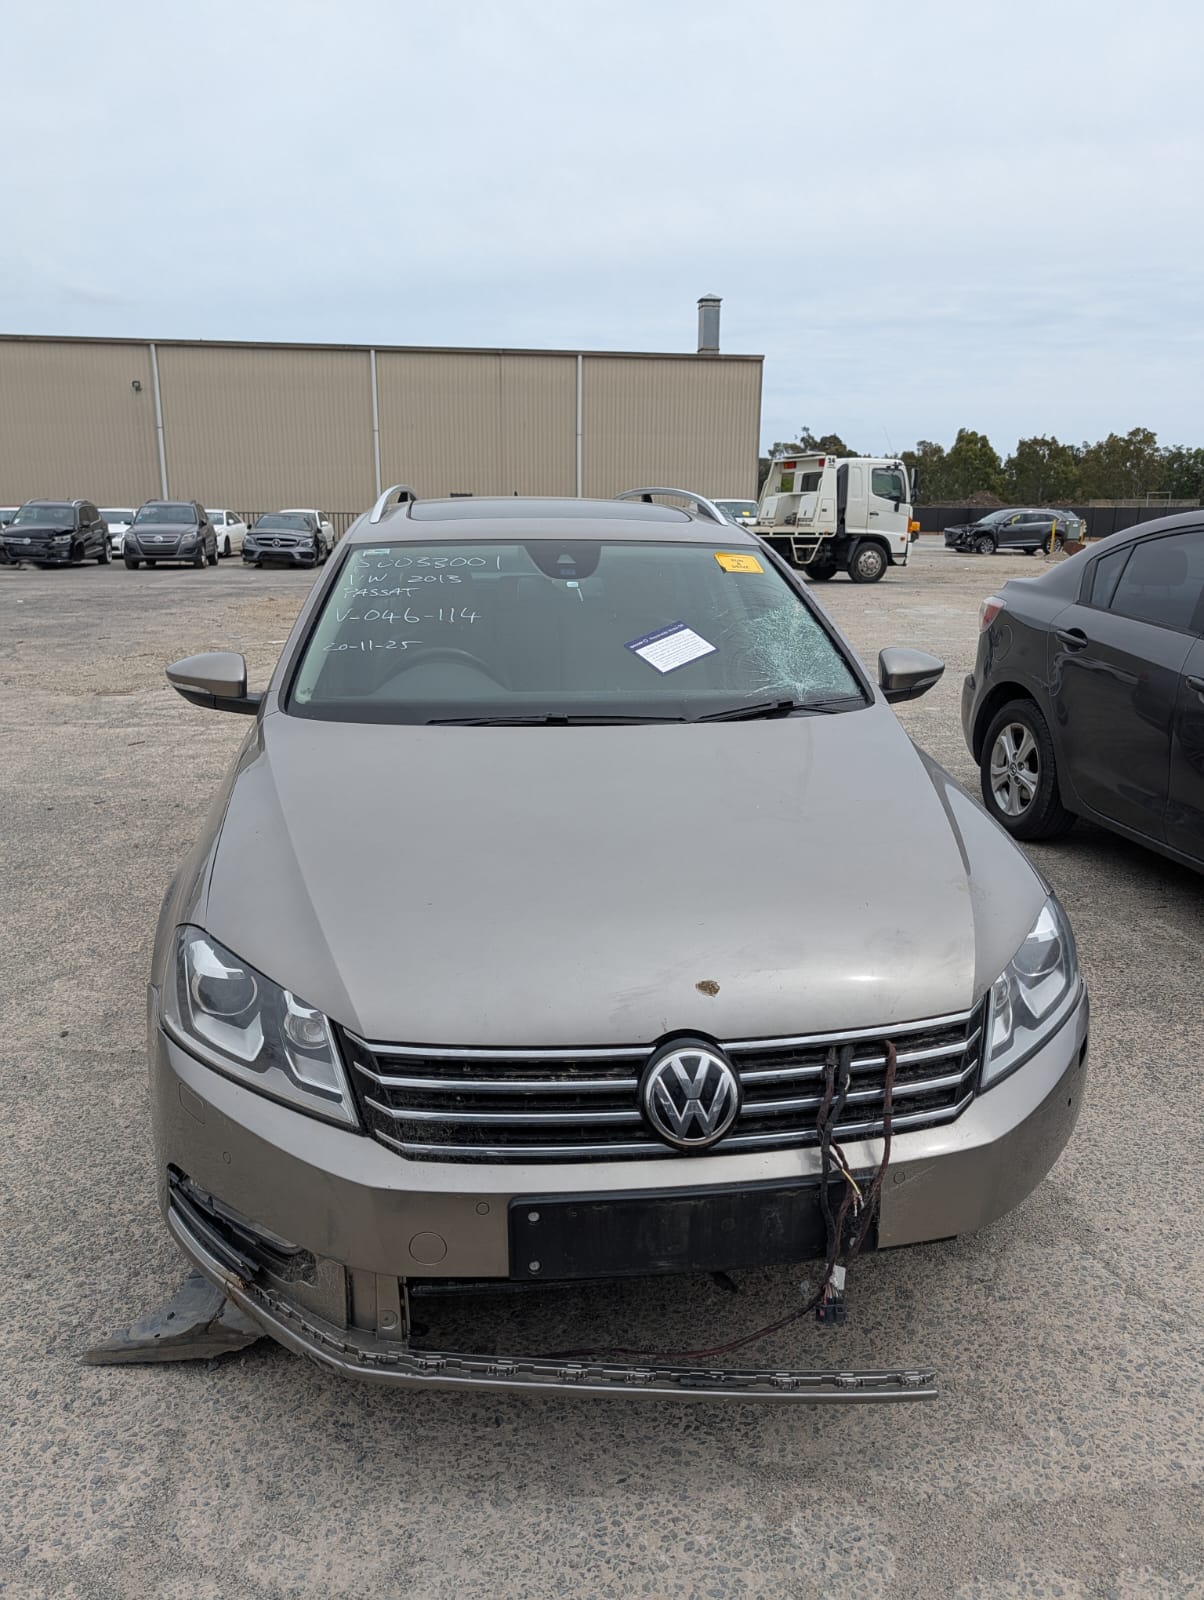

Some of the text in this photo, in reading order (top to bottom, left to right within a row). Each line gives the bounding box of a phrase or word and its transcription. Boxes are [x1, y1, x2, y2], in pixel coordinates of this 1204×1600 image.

[407, 574, 462, 584] 2013
[343, 587, 421, 598] PASSAT
[336, 607, 482, 624] V-046-114
[322, 639, 424, 651] 20-11-25
